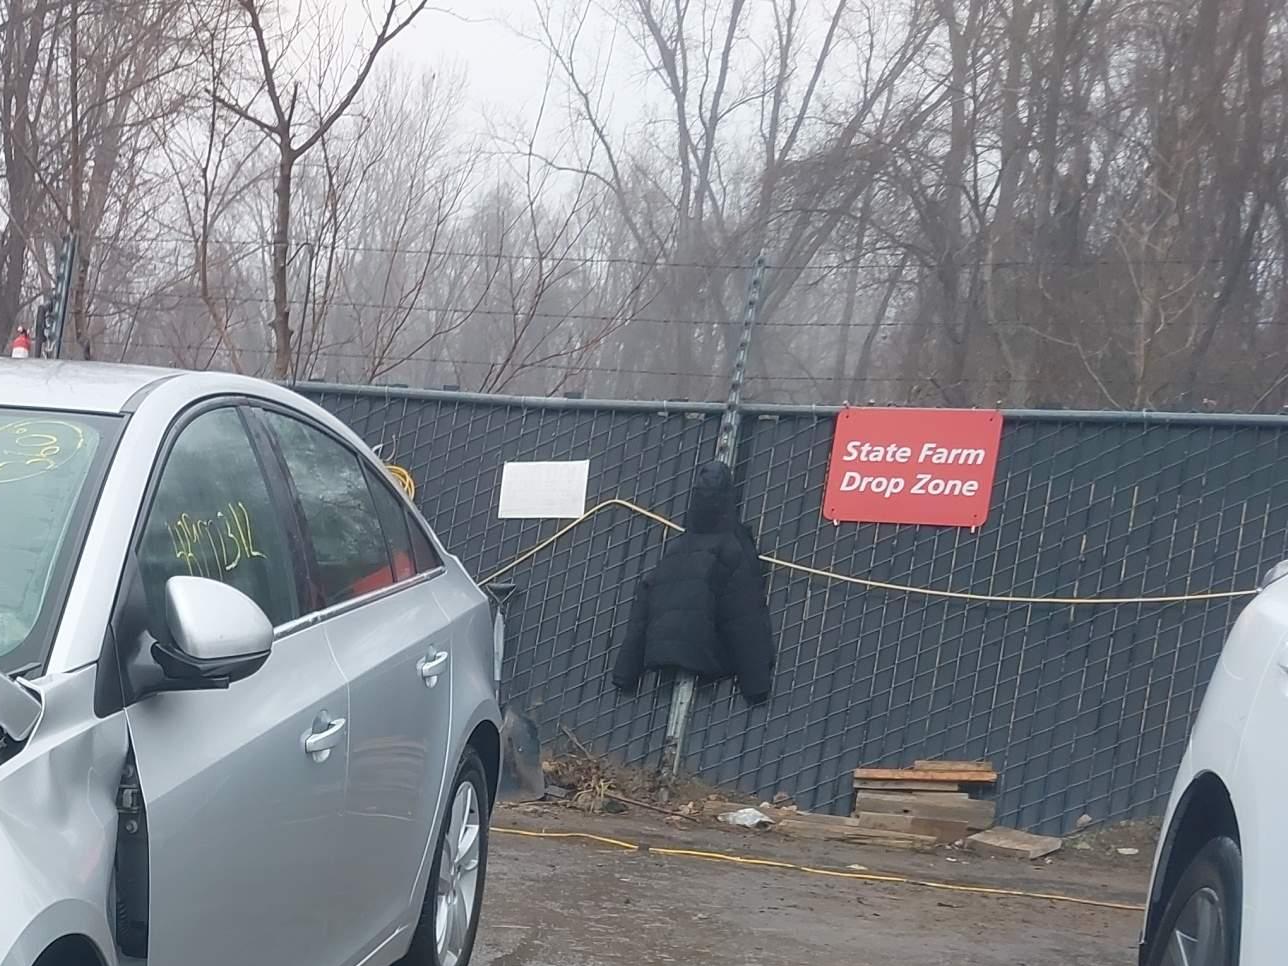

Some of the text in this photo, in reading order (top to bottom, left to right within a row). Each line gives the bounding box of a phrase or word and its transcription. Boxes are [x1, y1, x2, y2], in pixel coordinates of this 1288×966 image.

[843, 441, 985, 465] State Farm
[840, 471, 979, 498] Drop Zone
